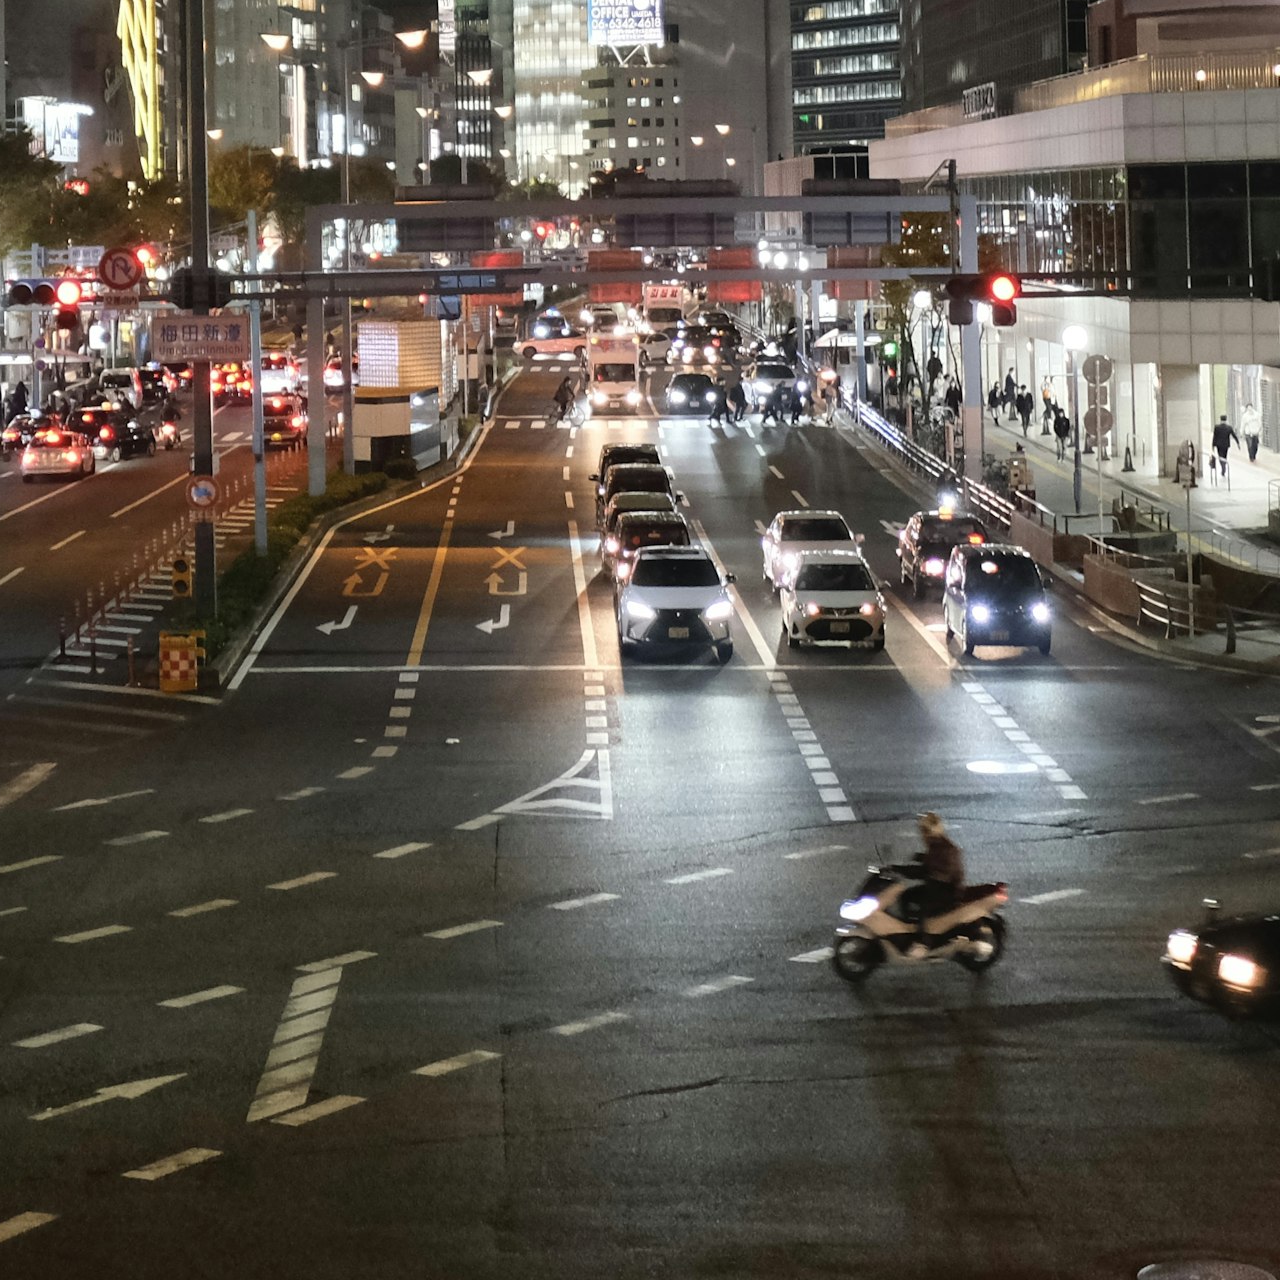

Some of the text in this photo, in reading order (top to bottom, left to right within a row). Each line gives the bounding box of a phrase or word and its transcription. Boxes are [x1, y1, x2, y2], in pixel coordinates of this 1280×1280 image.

[591, 7, 629, 18] OFFICE
[161, 324, 240, 342] 梅田新道
